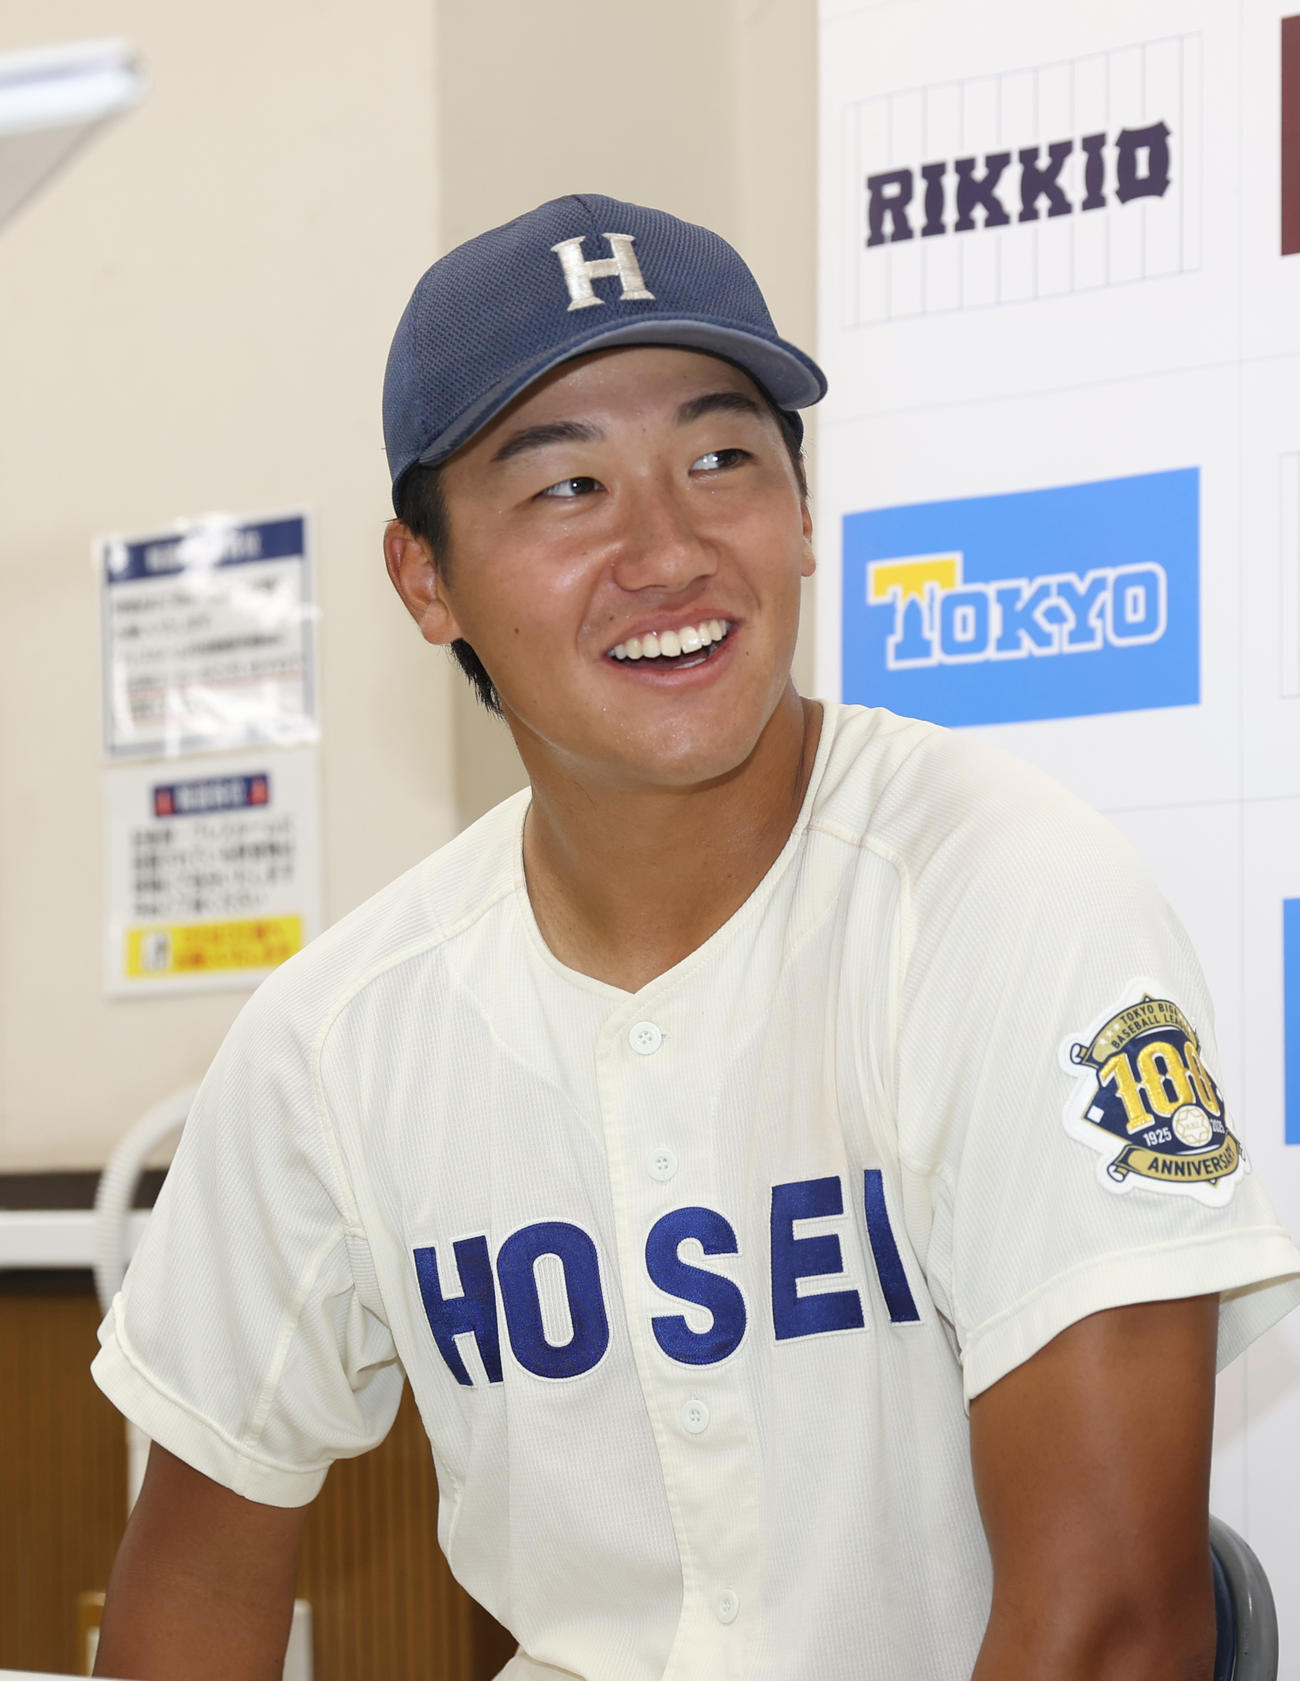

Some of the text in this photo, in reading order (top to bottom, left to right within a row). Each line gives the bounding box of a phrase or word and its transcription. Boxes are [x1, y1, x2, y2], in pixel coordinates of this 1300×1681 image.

[866, 120, 1172, 248] RIKKIO
[551, 233, 656, 311] H
[867, 551, 1168, 671] TOKYO
[1111, 1015, 1161, 1049] BASEBALL
[1120, 1004, 1154, 1025] TOKYO
[1099, 1041, 1221, 1134] 100
[1143, 1127, 1172, 1147] 1925
[413, 1169, 921, 1387] HOSEI
